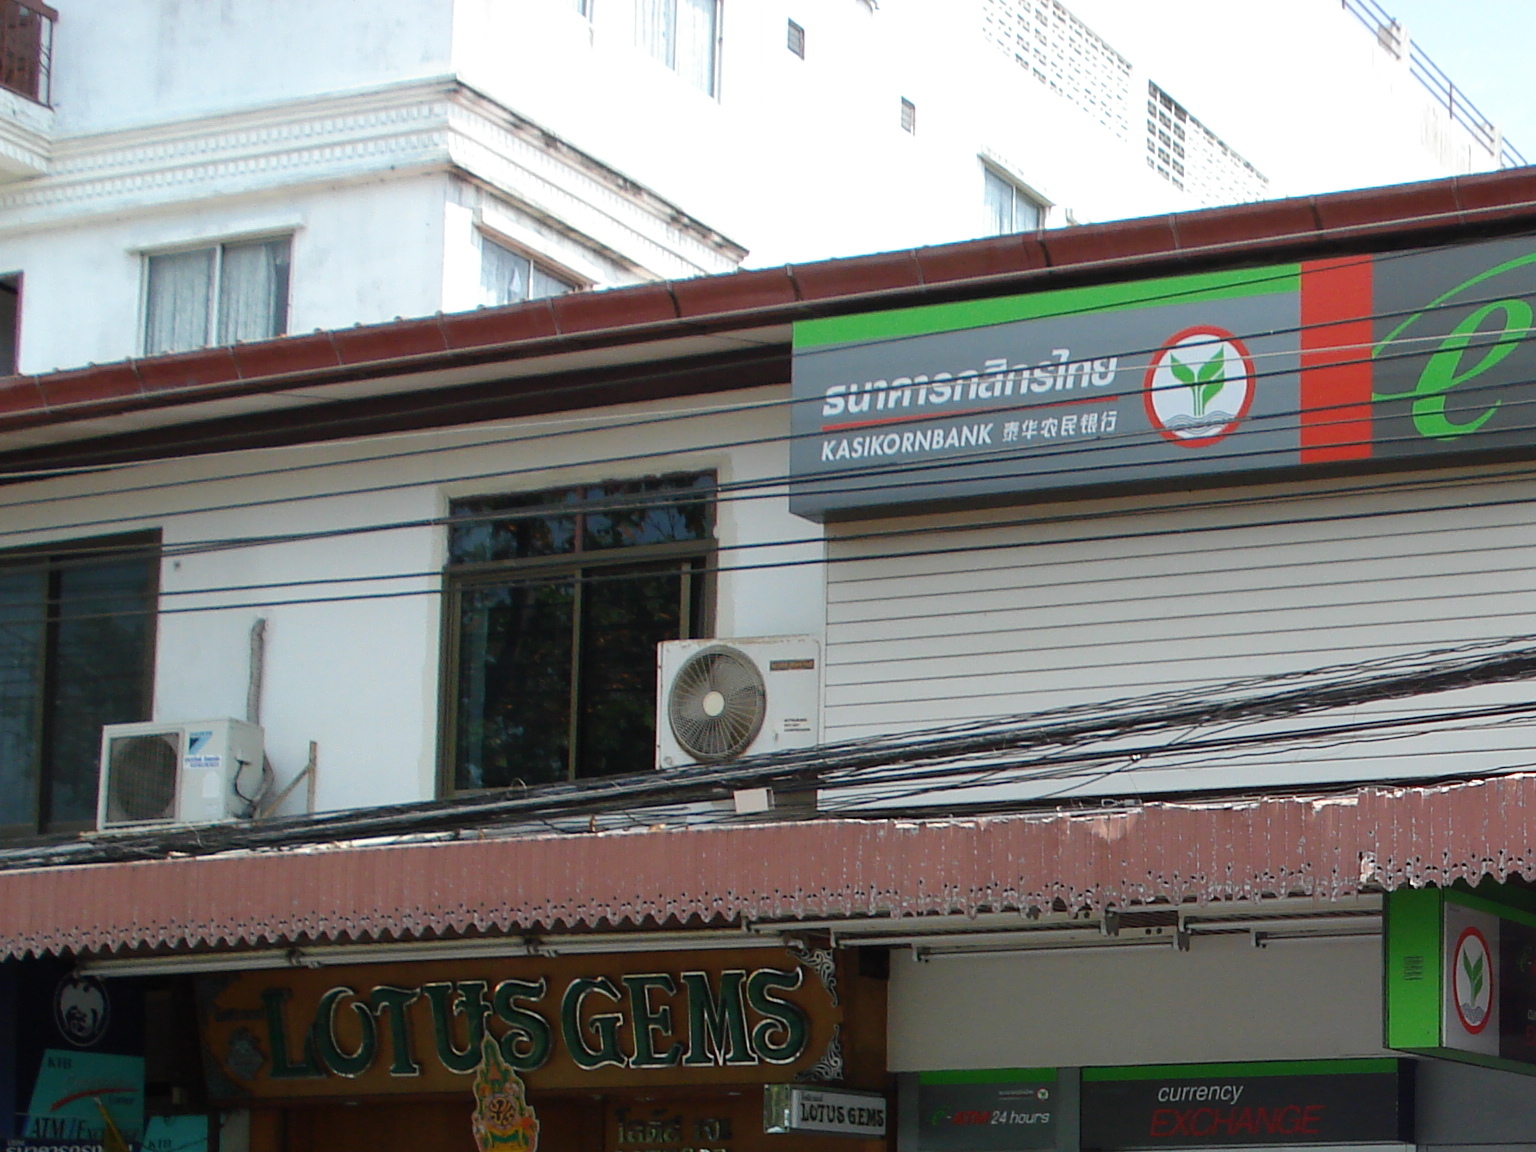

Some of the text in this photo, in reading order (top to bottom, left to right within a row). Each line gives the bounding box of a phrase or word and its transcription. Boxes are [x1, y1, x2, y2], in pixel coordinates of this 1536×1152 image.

[822, 348, 1118, 417] ธนาคารกสิกรไทย
[821, 423, 993, 461] KASIKORNBANK
[1003, 411, 1118, 442] 泰华农民银行
[264, 967, 812, 1079] LOTUS GEMS
[1158, 1083, 1244, 1104] currency
[801, 1103, 885, 1128] LOTUS GEMS
[991, 1110, 1007, 1125] 24
[1009, 1110, 1050, 1125] hours
[1149, 1104, 1326, 1137] EXCHANGE
